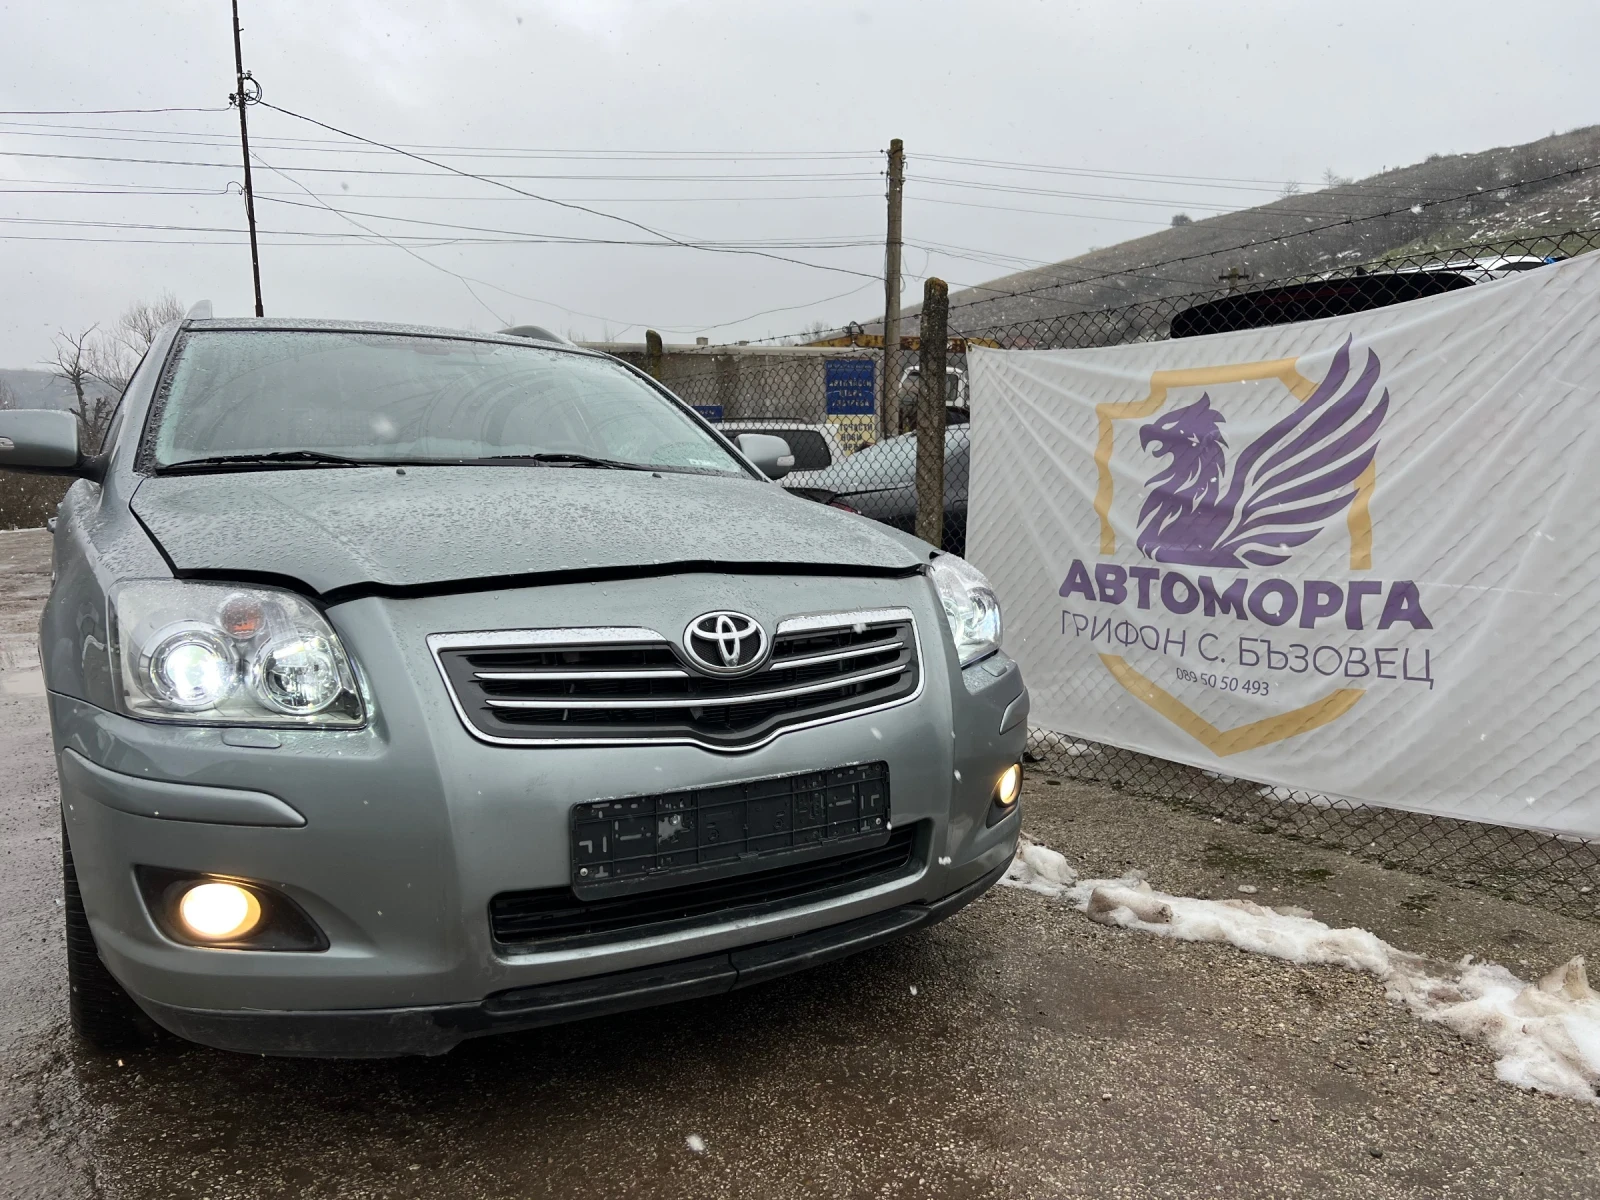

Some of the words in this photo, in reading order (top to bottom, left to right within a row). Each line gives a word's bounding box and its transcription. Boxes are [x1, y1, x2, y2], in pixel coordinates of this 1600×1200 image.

[1058, 558, 1434, 631] АВТОМОРГА
[1061, 609, 1187, 658] ГРИФОН
[1197, 632, 1226, 664] С.
[1238, 636, 1435, 690] БЪЗОВЕЦ
[1176, 667, 1198, 683] 089
[1200, 673, 1217, 688] 50
[1220, 676, 1239, 692] 50
[1241, 679, 1270, 697] 493
